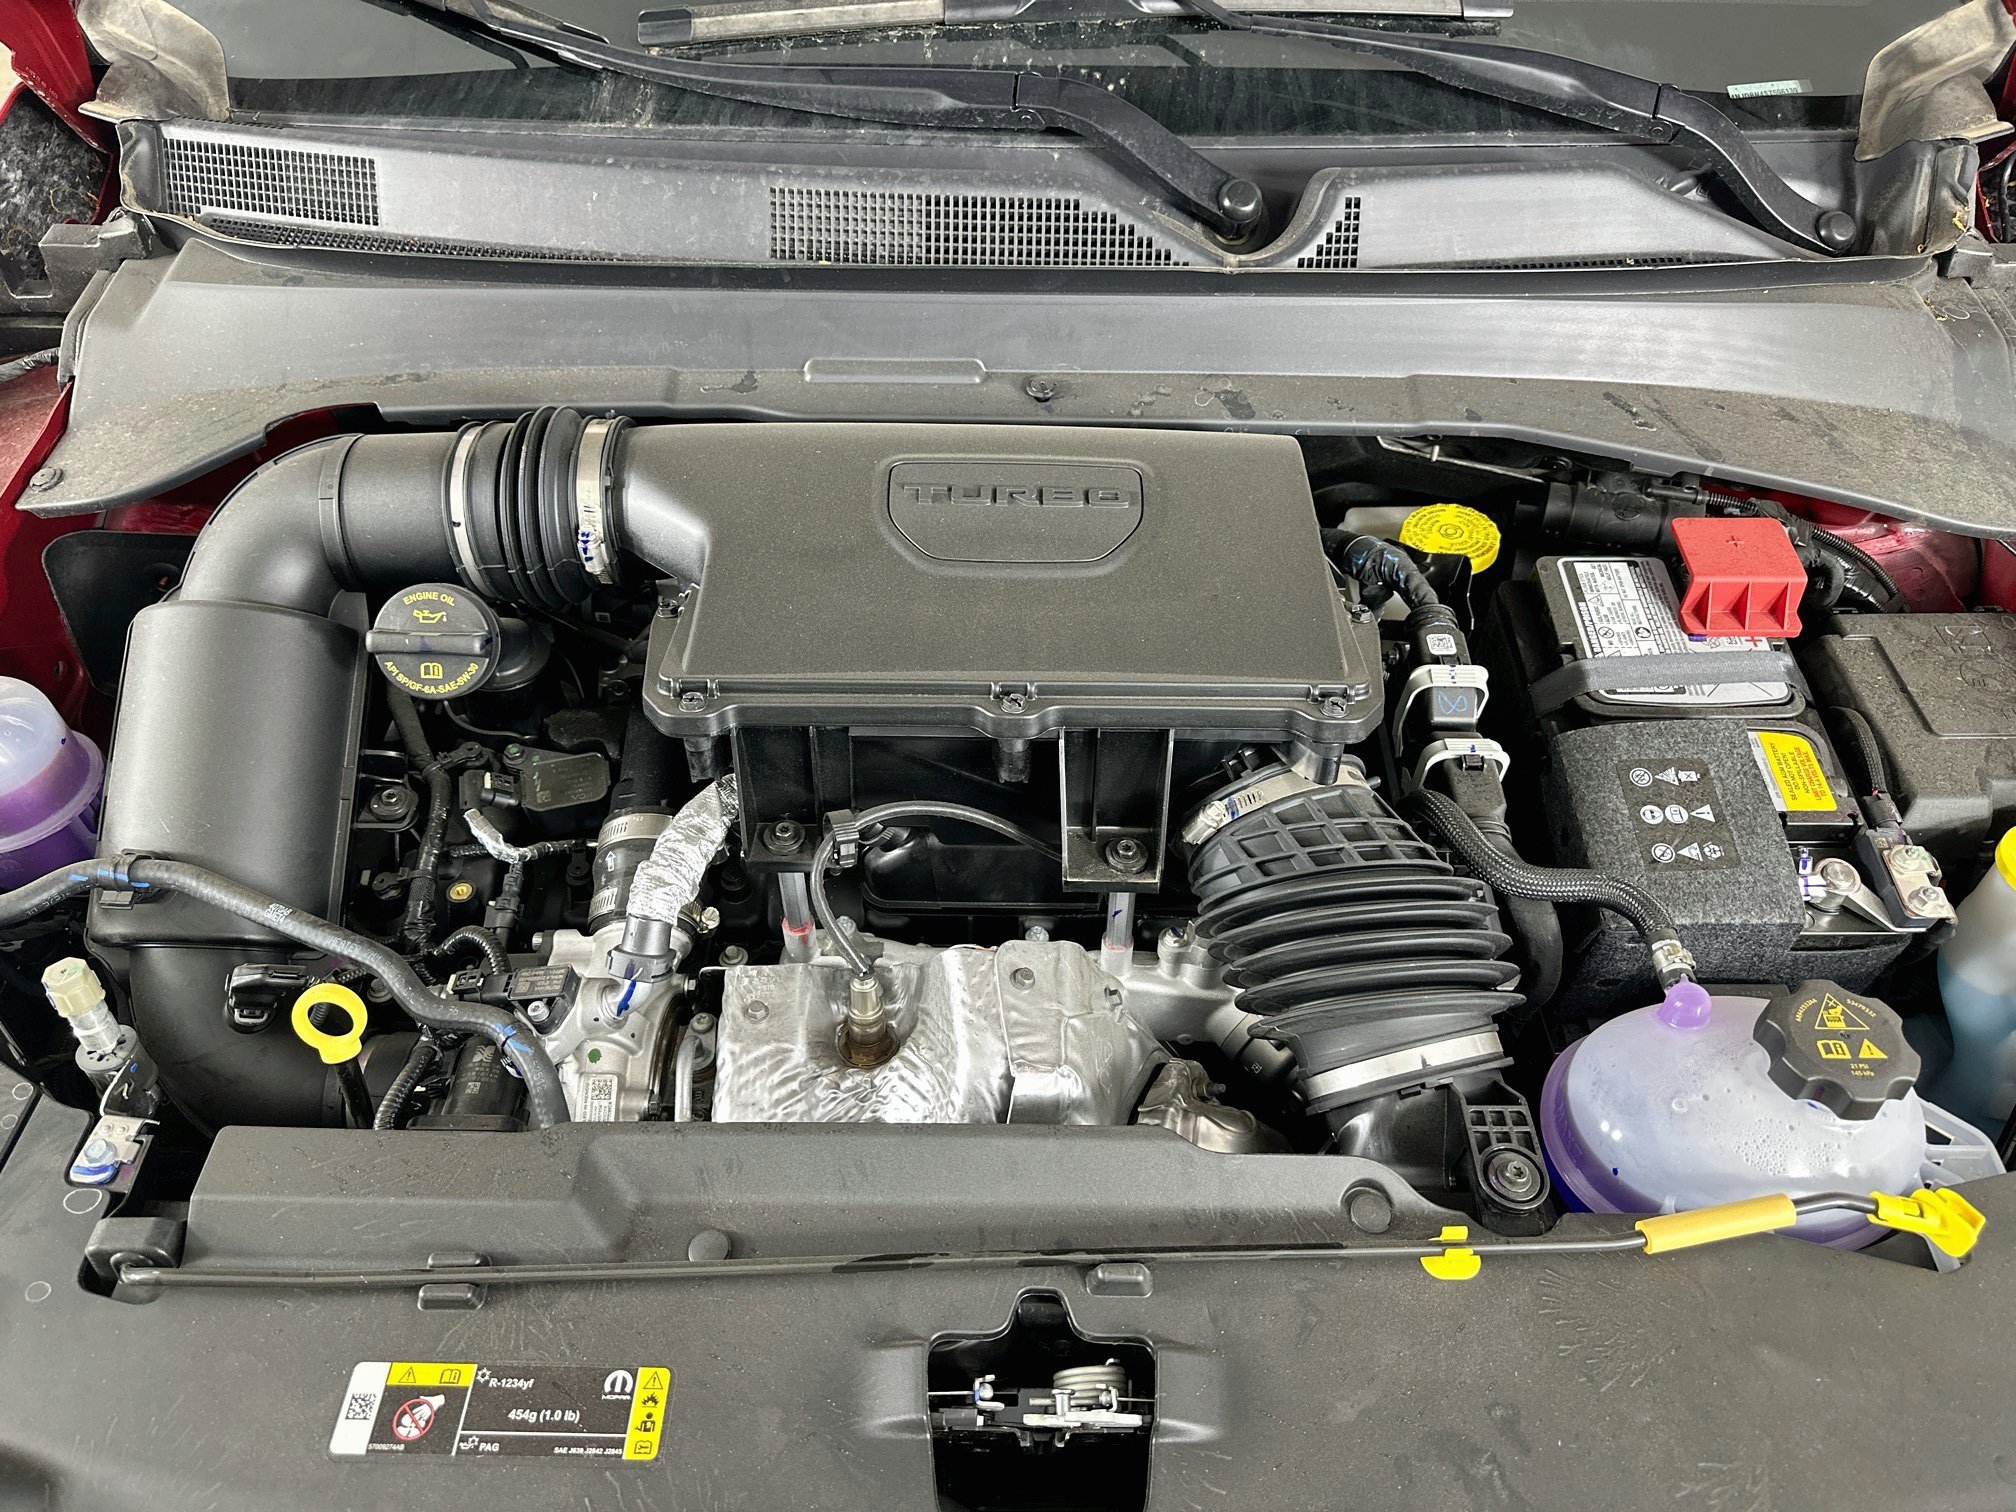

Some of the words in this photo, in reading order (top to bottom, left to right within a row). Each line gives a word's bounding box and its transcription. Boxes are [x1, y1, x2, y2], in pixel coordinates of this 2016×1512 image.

[903, 485, 1129, 509] TURBO
[403, 591, 438, 605] ENGINE
[440, 594, 455, 606] OIL
[1578, 602, 1601, 652] DANGER/POISON
[384, 661, 399, 677] API
[489, 1377, 534, 1389] R-1234yf
[508, 1408, 536, 1422] 454g
[539, 1409, 562, 1422] (1.0
[564, 1409, 580, 1423] lb)
[479, 1441, 500, 1451] PAG
[553, 1446, 567, 1454] SAE
